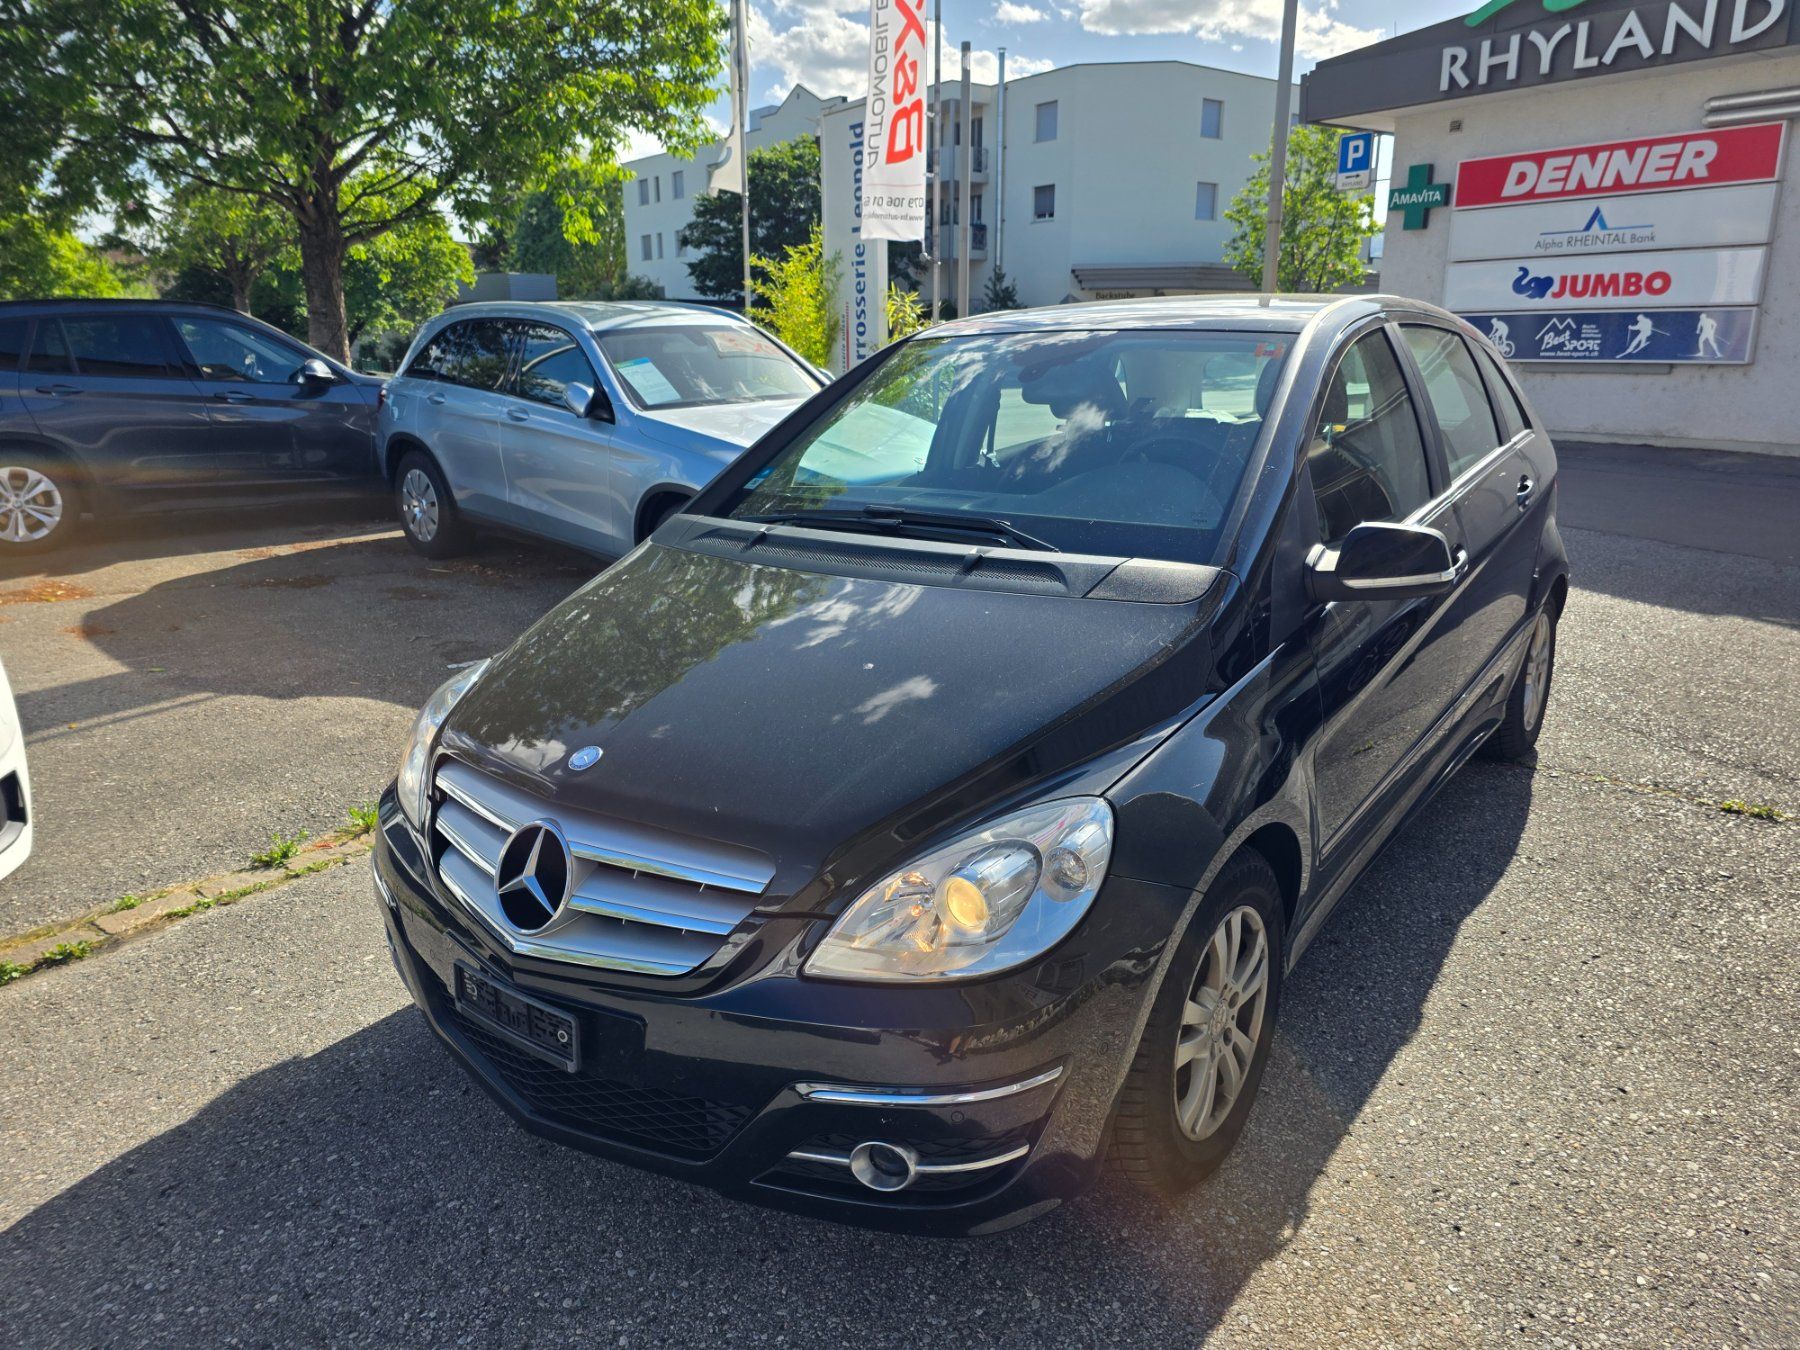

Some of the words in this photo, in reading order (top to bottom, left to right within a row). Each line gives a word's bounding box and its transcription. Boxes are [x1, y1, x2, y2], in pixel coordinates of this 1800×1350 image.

[1439, 0, 1785, 92] RHYLAND
[1346, 139, 1365, 169] P
[1500, 139, 1719, 198] DENNER
[1534, 239, 1563, 252] Alpha
[1566, 233, 1628, 247] RHEINTAL
[1630, 232, 1656, 244] Bank
[1551, 271, 1672, 299] JUMBO
[851, 243, 867, 361] rrosserie
[1541, 330, 1571, 350] Beat
[1563, 339, 1602, 351] SPORT
